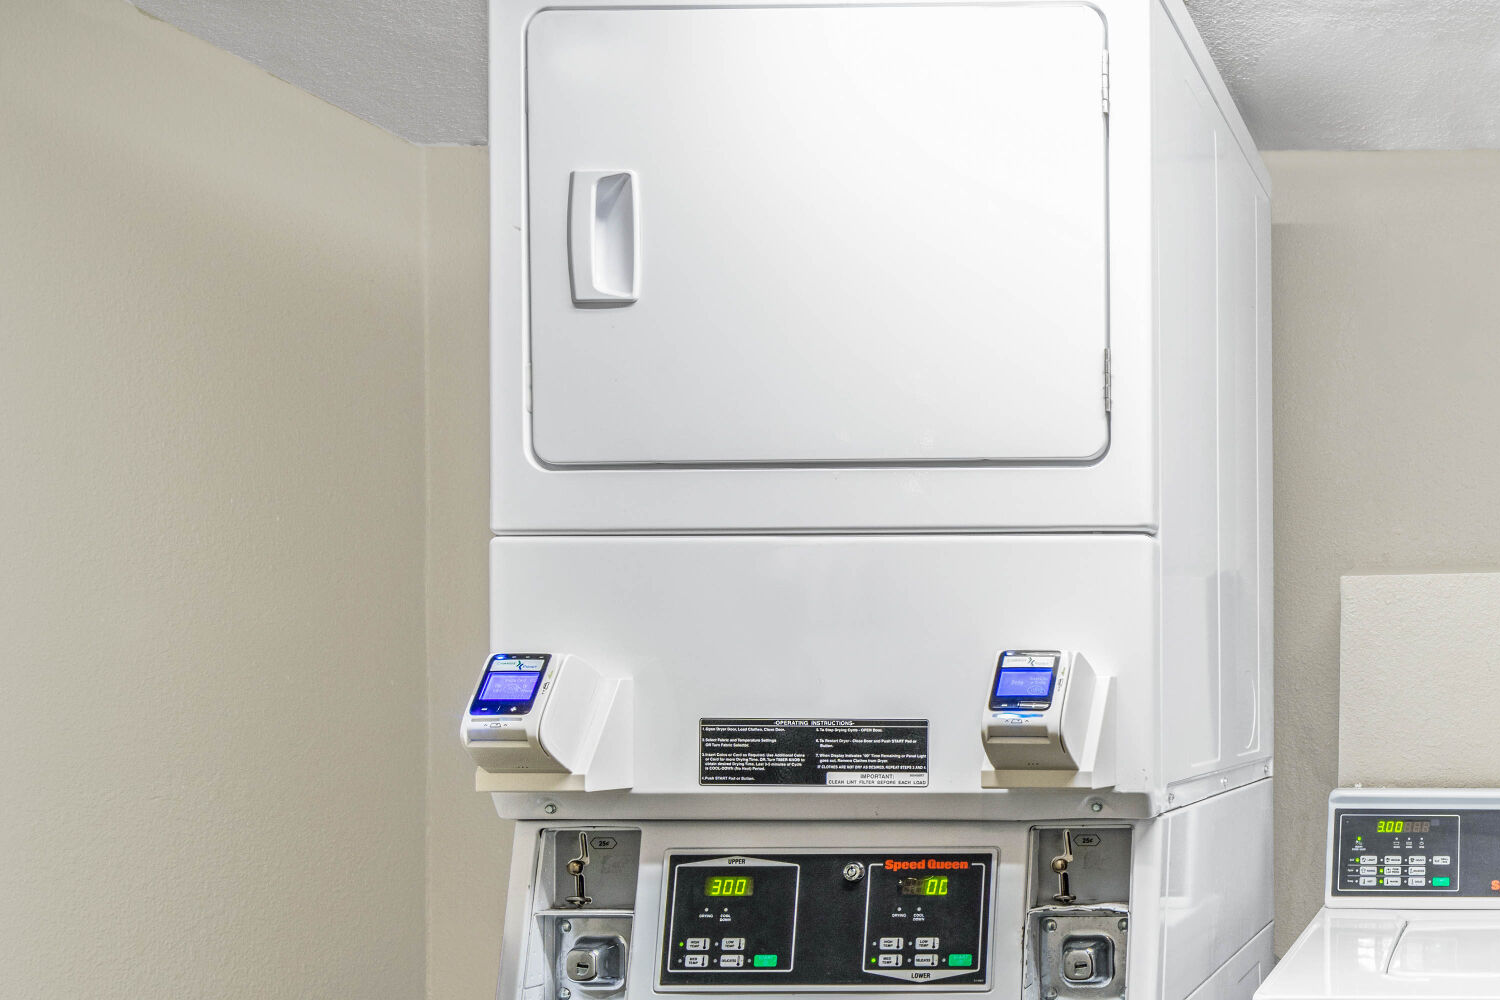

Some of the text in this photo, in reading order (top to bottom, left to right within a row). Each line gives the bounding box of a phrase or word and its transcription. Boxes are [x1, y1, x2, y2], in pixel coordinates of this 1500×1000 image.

[884, 859, 969, 871] Speed Queen
[712, 880, 747, 895] 300
